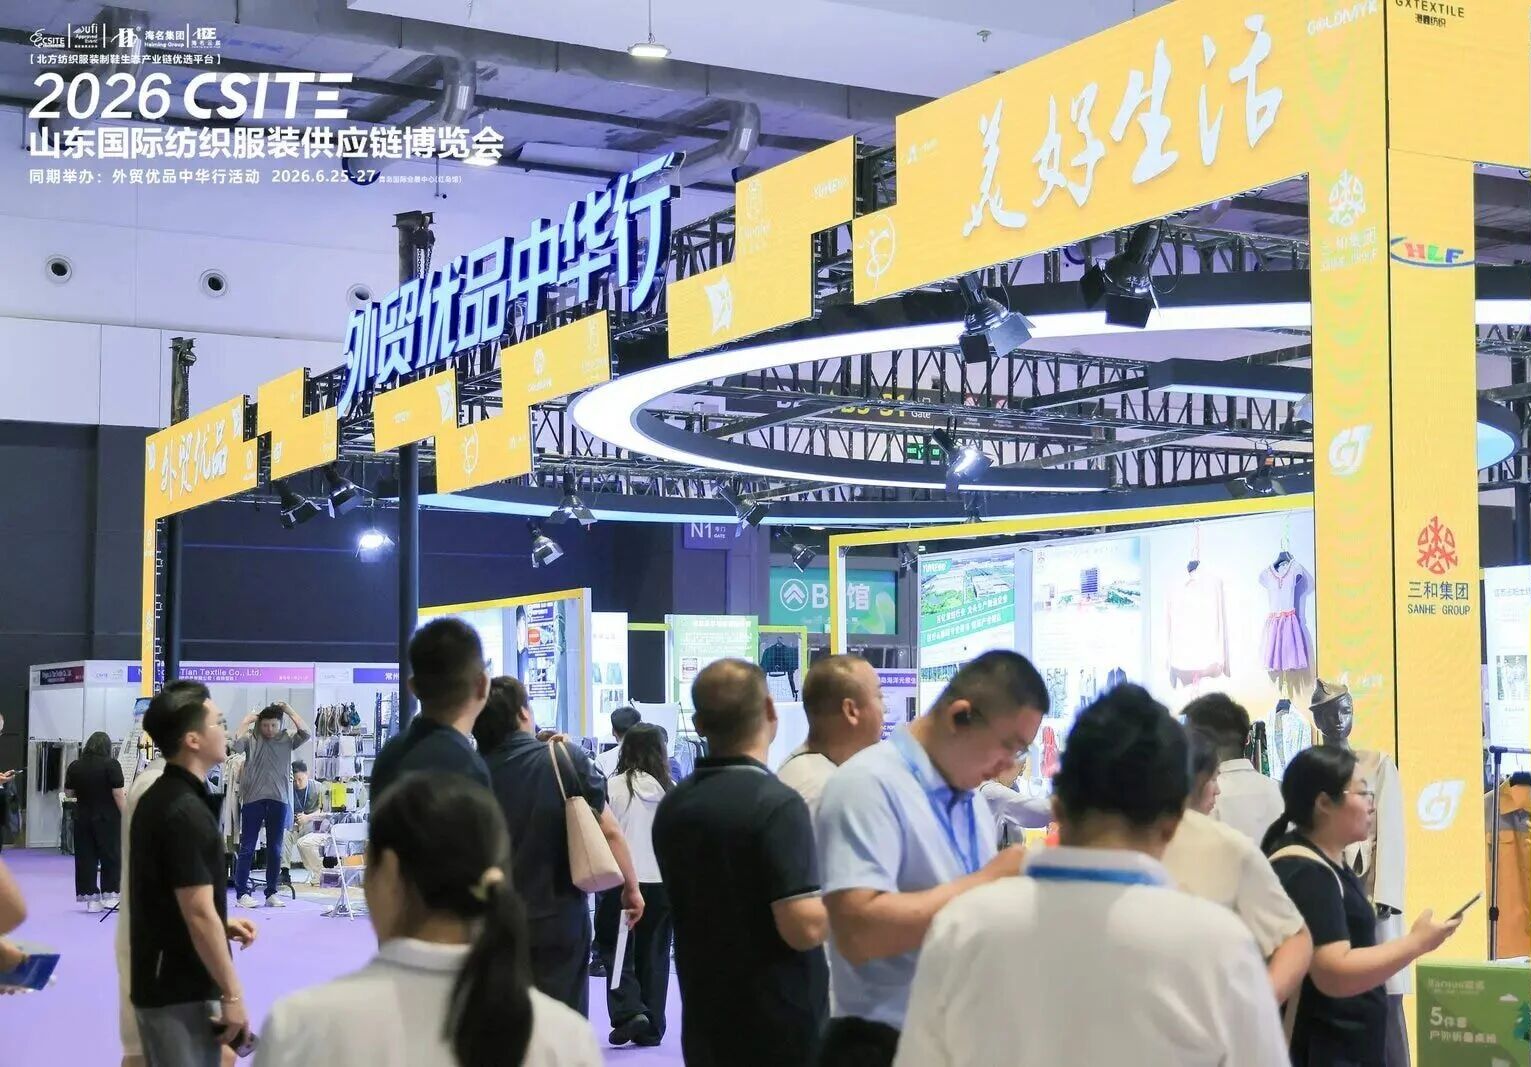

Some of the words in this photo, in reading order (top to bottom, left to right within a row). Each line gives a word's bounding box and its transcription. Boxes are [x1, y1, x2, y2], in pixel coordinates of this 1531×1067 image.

[962, 14, 1284, 238] 美好生活
[1404, 242, 1465, 263] HLF
[336, 151, 686, 420] 外贸优品中华行
[160, 419, 229, 502] 外贸优品
[1407, 581, 1469, 600] 三和集团
[1407, 603, 1436, 615] SANHE
[1441, 604, 1470, 616] GROUP
[200, 668, 226, 676] Textile
